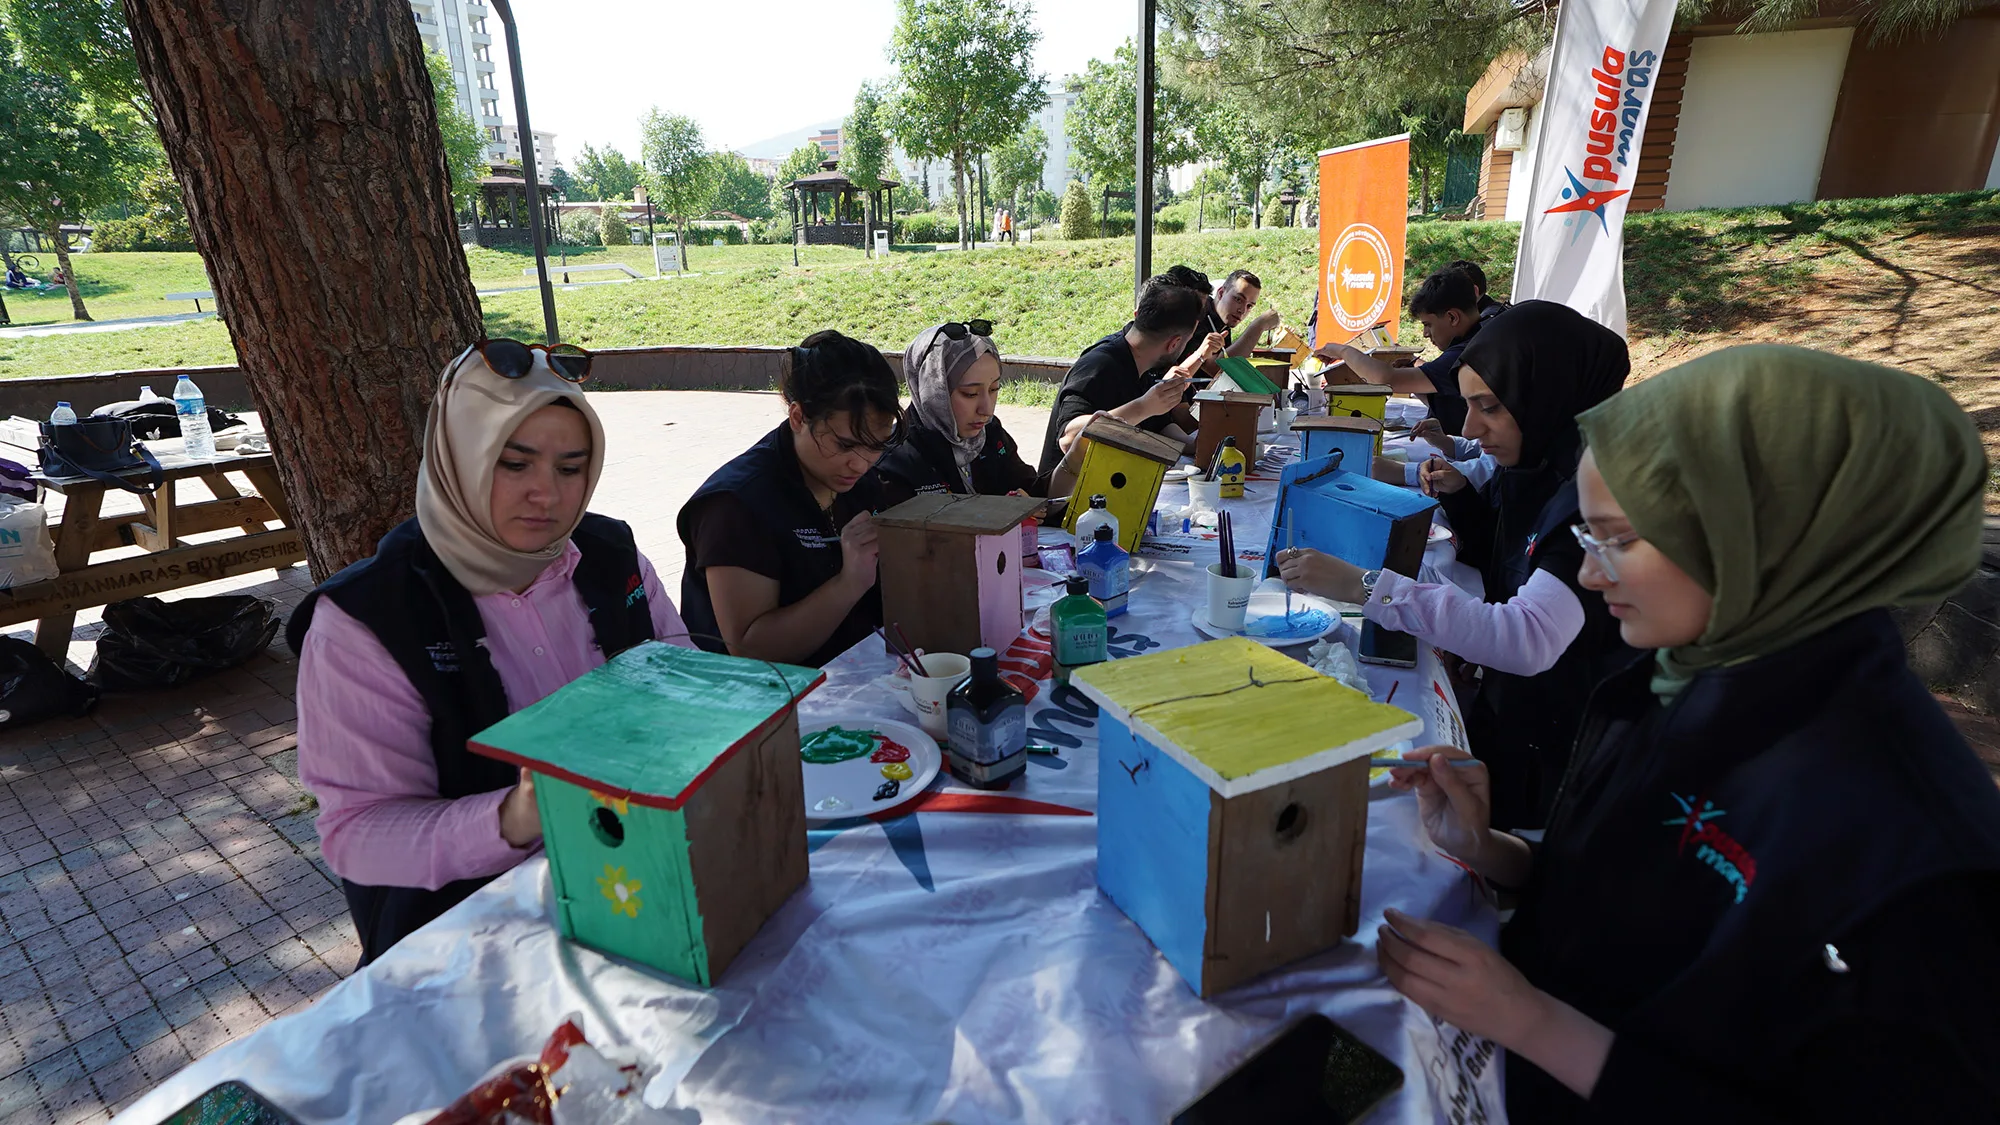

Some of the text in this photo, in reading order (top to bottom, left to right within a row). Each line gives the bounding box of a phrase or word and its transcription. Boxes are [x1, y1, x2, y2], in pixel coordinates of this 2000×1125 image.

[1583, 45, 1626, 184] pusula
[1617, 50, 1657, 167] maraş
[1346, 298, 1385, 328] TOPLULUĞU
[187, 540, 299, 575] BÜYÜKŞEHİR
